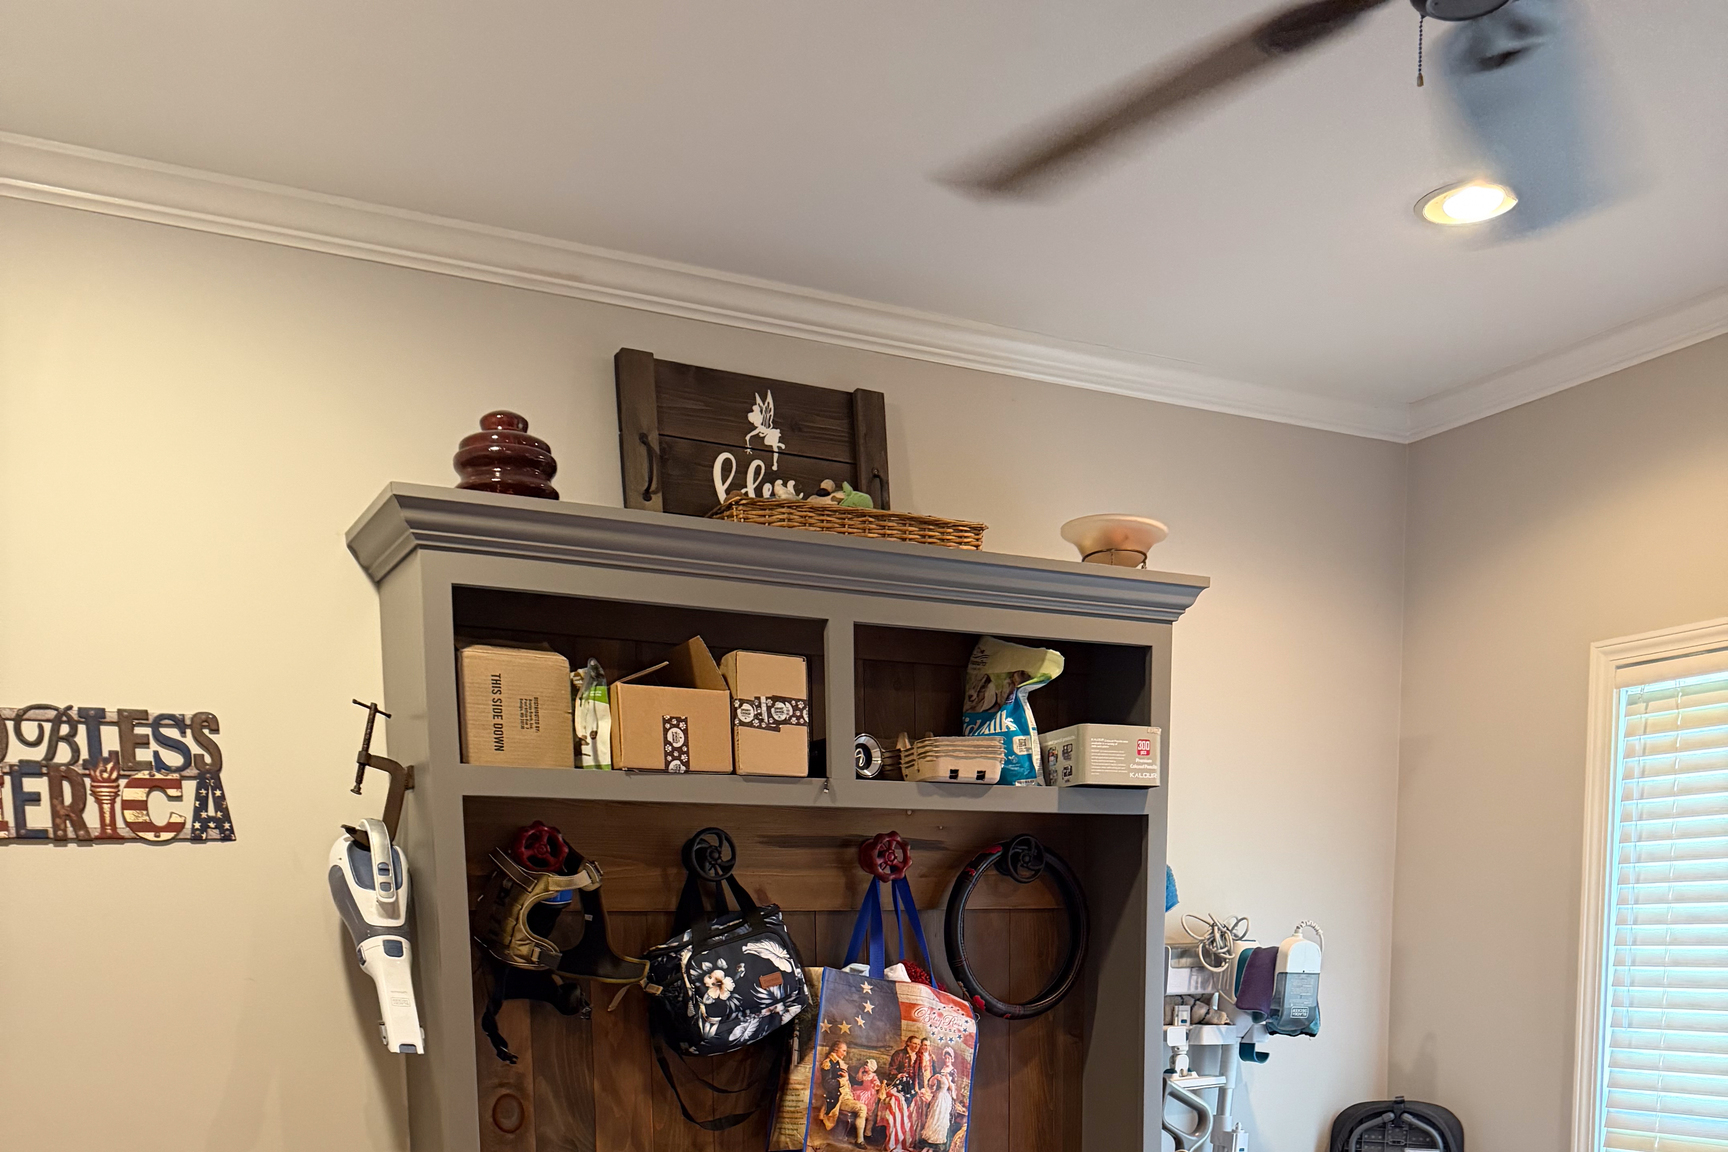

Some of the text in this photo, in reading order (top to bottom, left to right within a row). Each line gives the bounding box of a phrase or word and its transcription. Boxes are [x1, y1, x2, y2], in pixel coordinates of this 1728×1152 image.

[14, 703, 222, 773] BLESS
[491, 673, 504, 752] THIS SIDE DOWN
[1137, 741, 1150, 751] 300
[0, 758, 236, 842] ERICA
